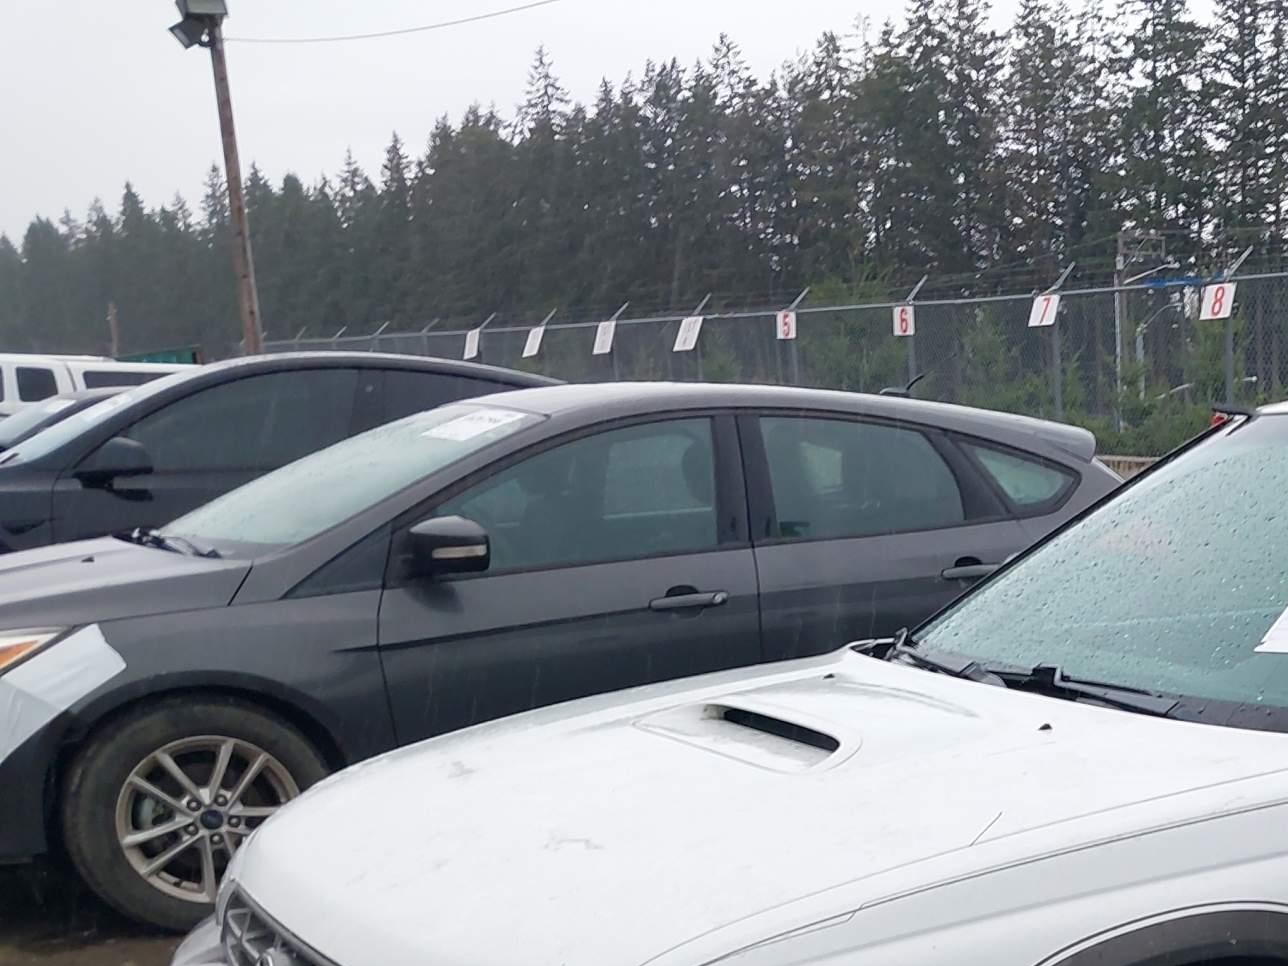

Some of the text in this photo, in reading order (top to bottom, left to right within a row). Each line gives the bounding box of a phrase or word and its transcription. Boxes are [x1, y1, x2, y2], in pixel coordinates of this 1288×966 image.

[1039, 298, 1051, 323] 7
[1211, 287, 1226, 316] 8
[782, 314, 791, 336] 5
[899, 310, 909, 333] 6
